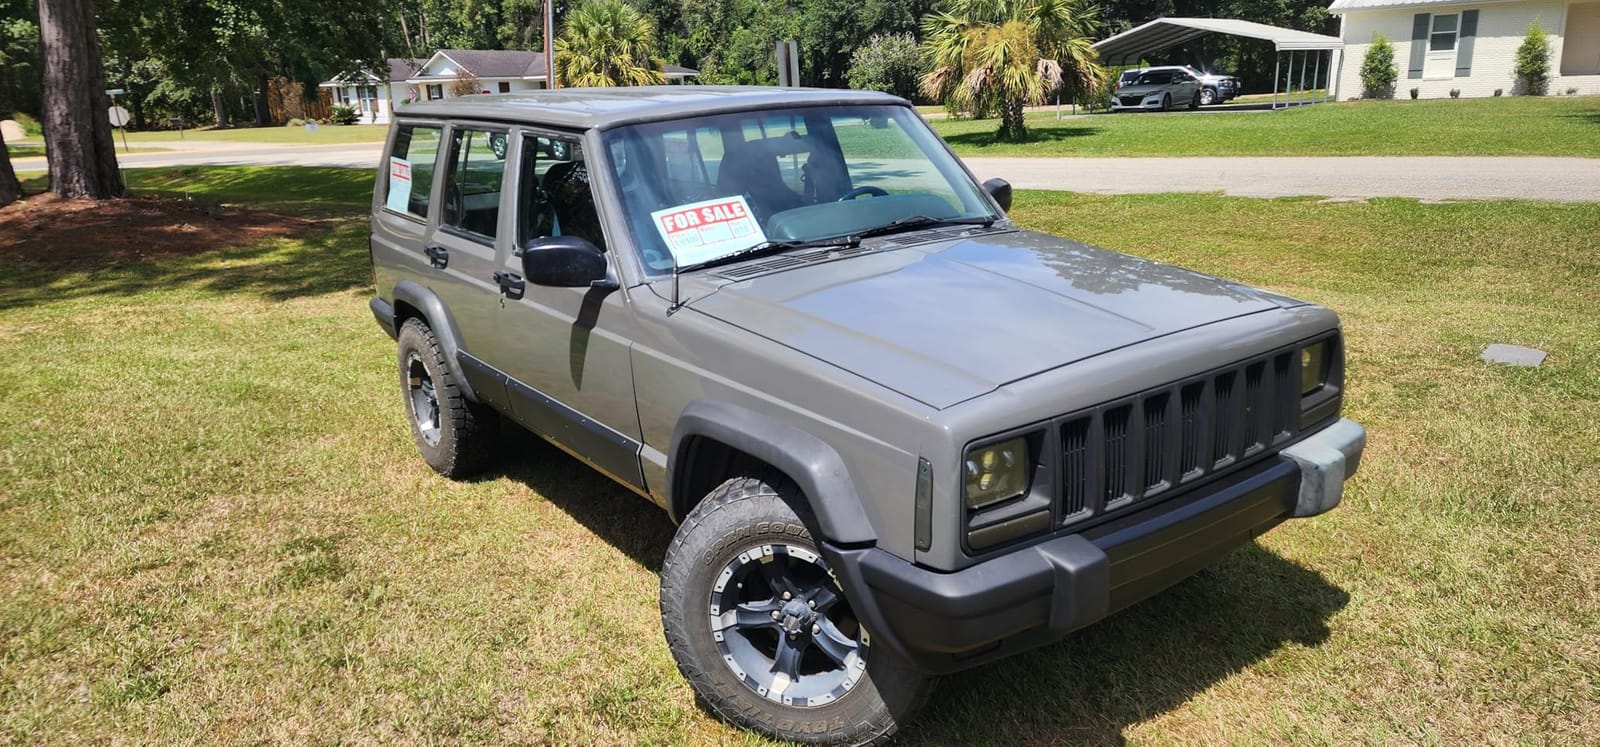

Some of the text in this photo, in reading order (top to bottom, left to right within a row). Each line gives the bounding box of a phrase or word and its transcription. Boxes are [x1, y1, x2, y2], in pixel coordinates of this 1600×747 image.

[663, 203, 746, 231] FOR SALE
[703, 525, 751, 566] OPEN
[776, 716, 844, 734] TOYO
